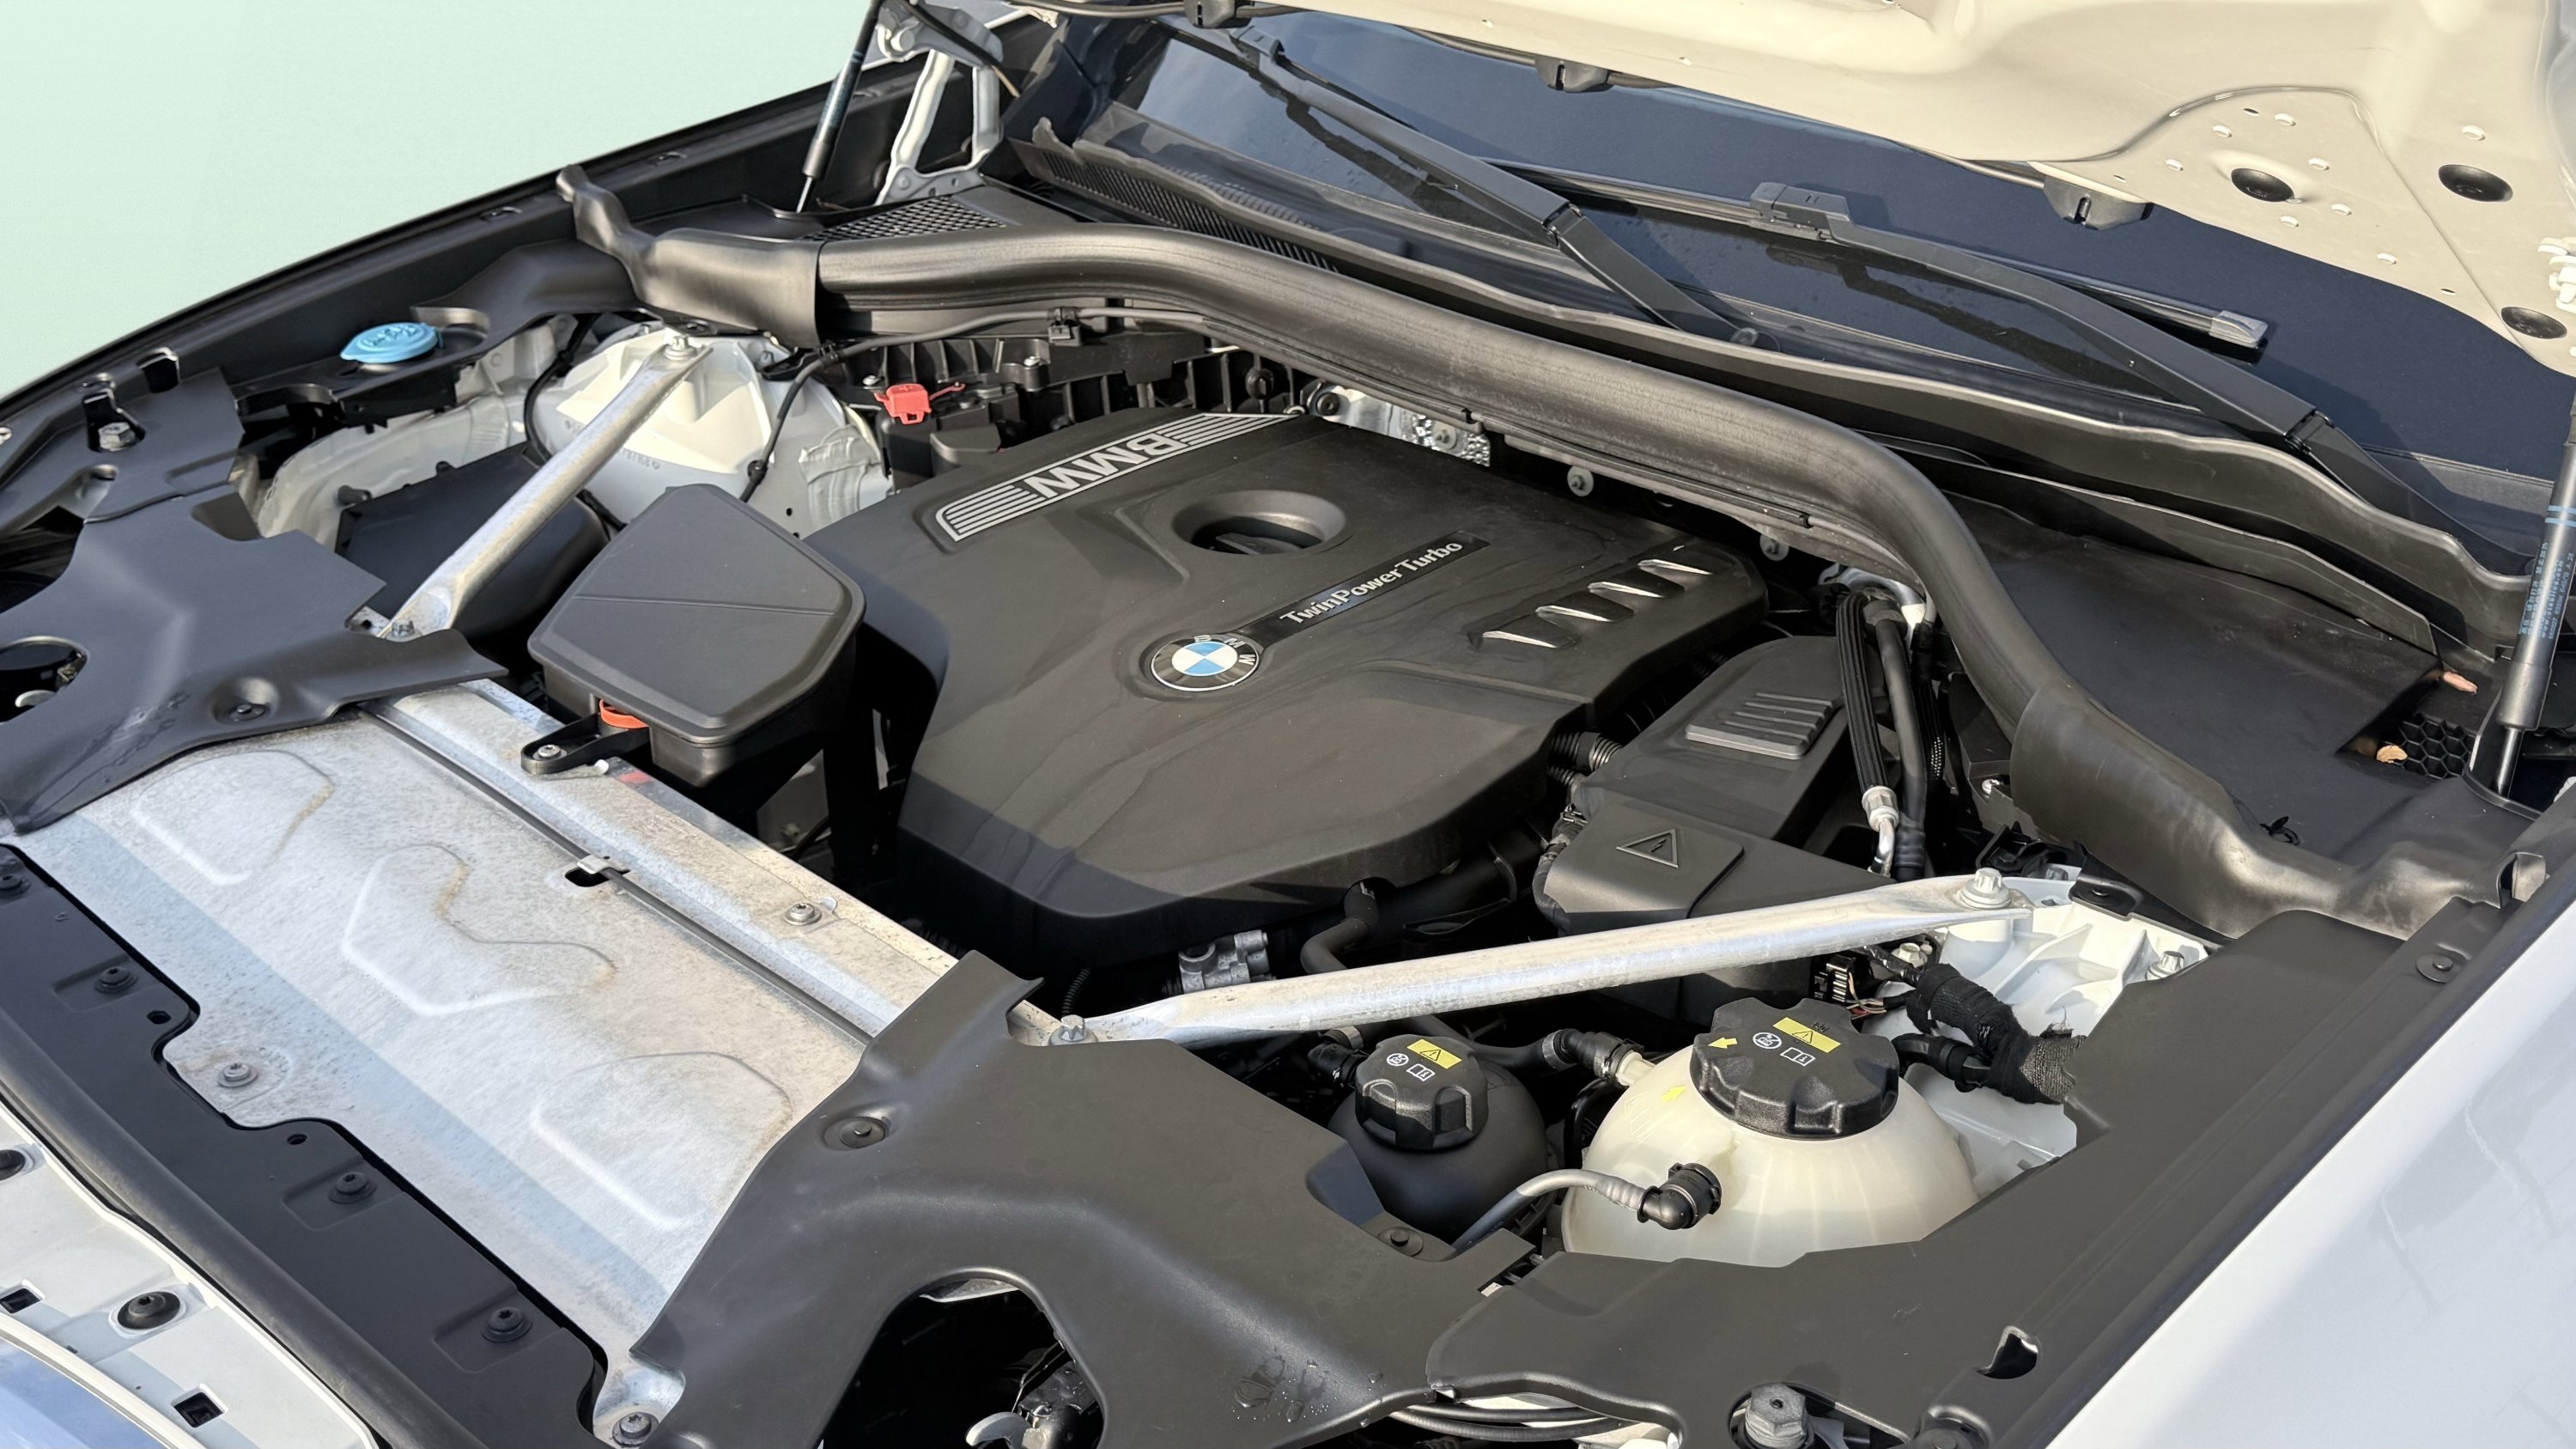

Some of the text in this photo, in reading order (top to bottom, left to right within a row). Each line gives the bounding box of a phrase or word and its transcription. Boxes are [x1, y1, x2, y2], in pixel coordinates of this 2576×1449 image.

[1023, 433, 1188, 498] BMW
[1279, 541, 1463, 624] TwinPowerTurbo
[1194, 635, 1255, 666] BMW
